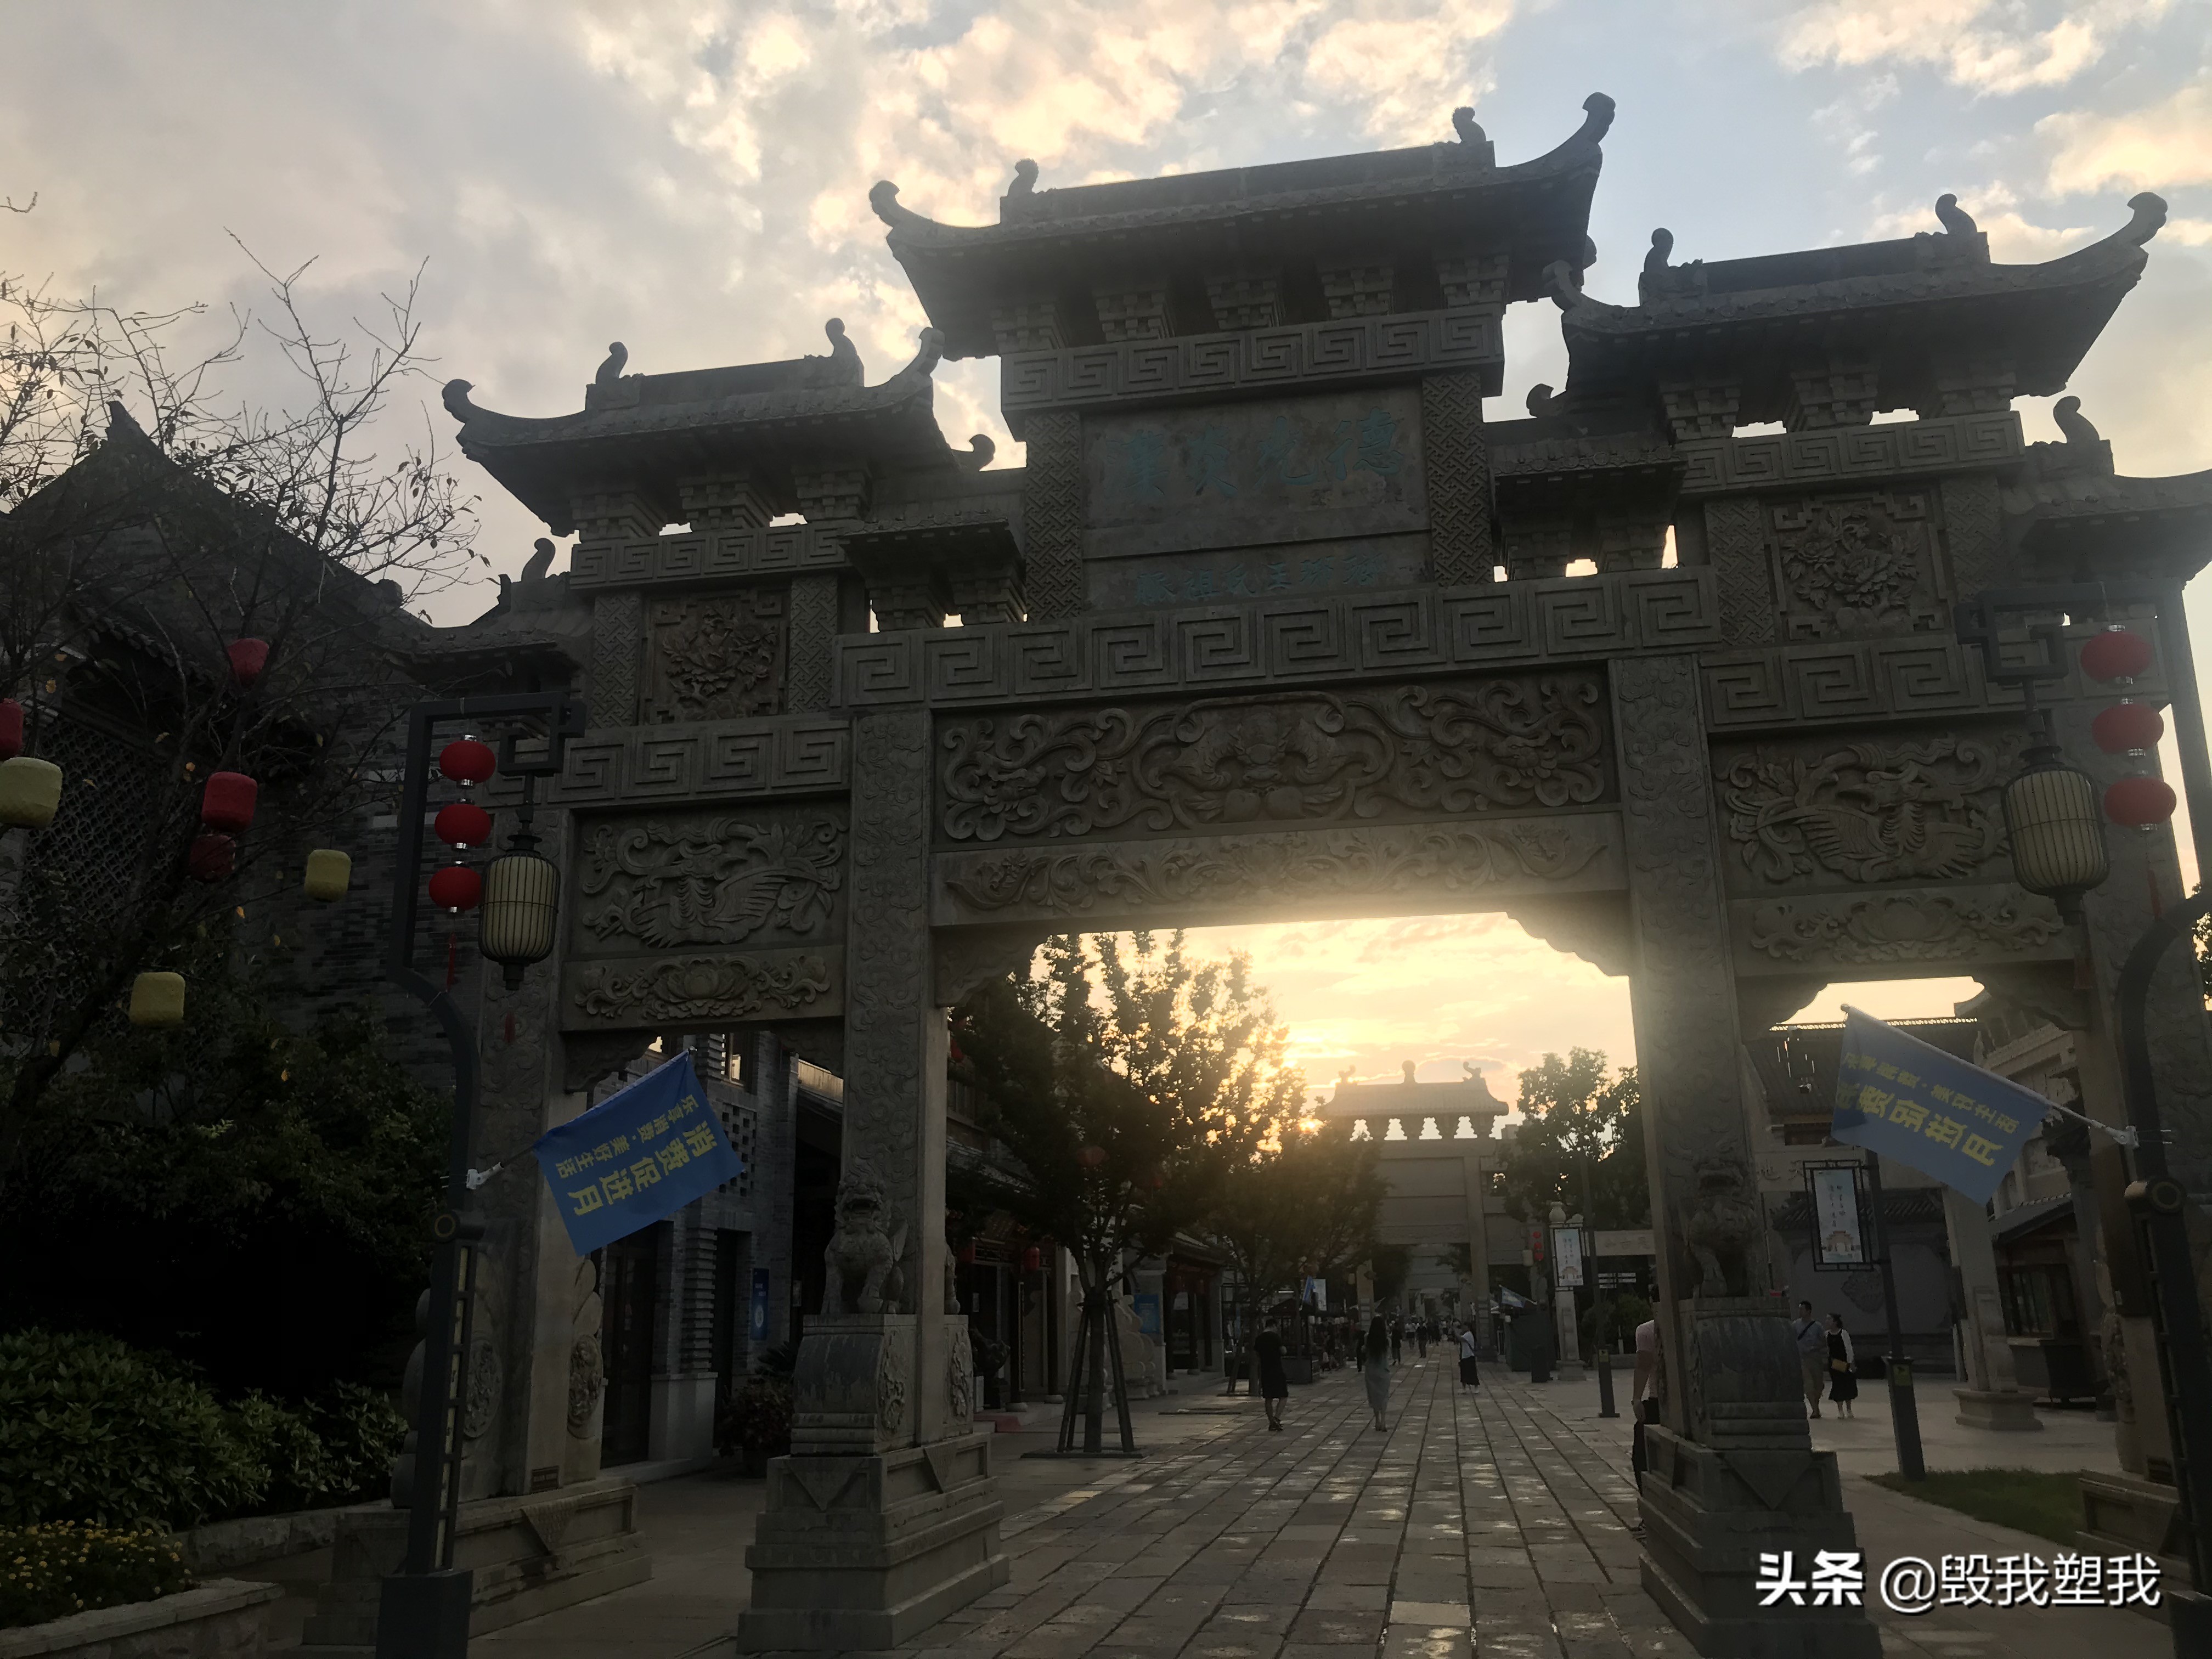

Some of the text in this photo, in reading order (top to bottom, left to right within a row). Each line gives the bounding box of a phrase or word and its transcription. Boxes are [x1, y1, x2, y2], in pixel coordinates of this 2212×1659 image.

[567, 1120, 718, 1216] 消费促进月
